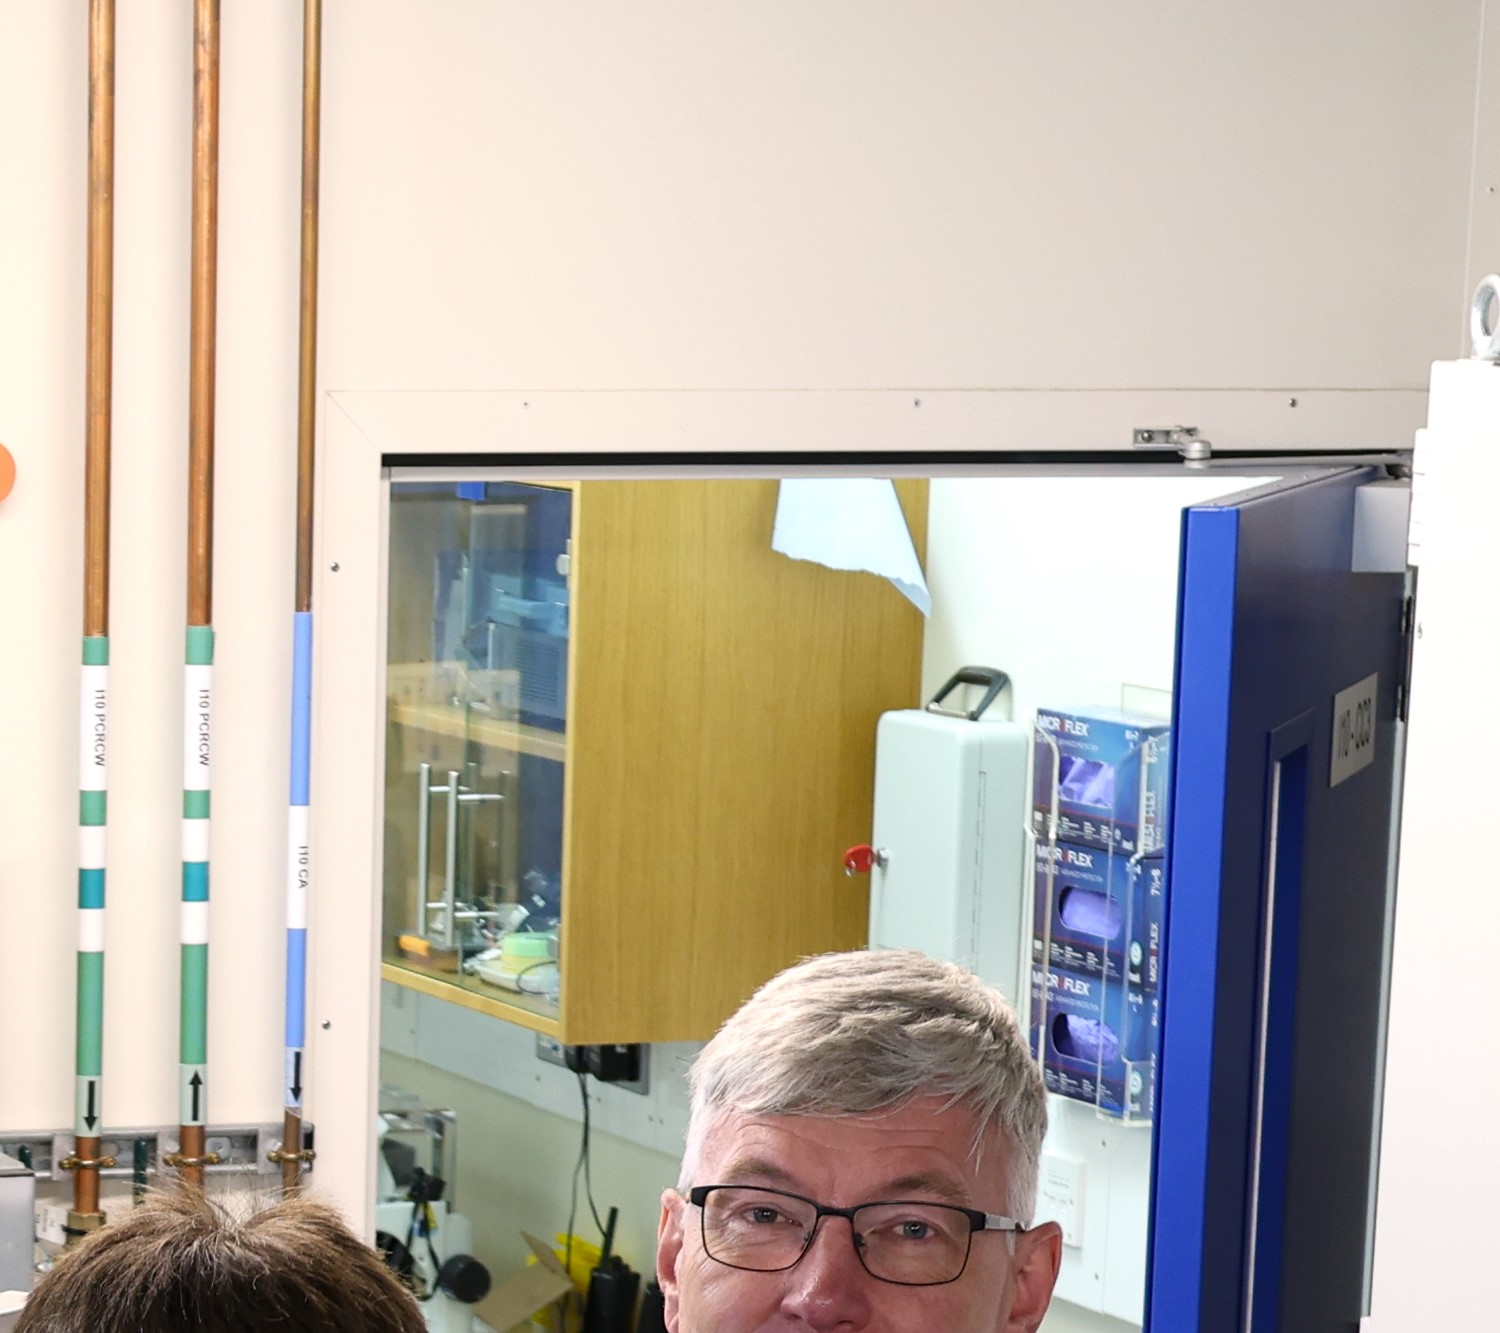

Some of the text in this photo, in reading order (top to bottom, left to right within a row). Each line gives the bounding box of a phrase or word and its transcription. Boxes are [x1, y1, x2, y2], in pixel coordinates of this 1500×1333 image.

[94, 714, 106, 767] PCRCW
[198, 713, 210, 766] PCRCW
[298, 869, 309, 889] CA
